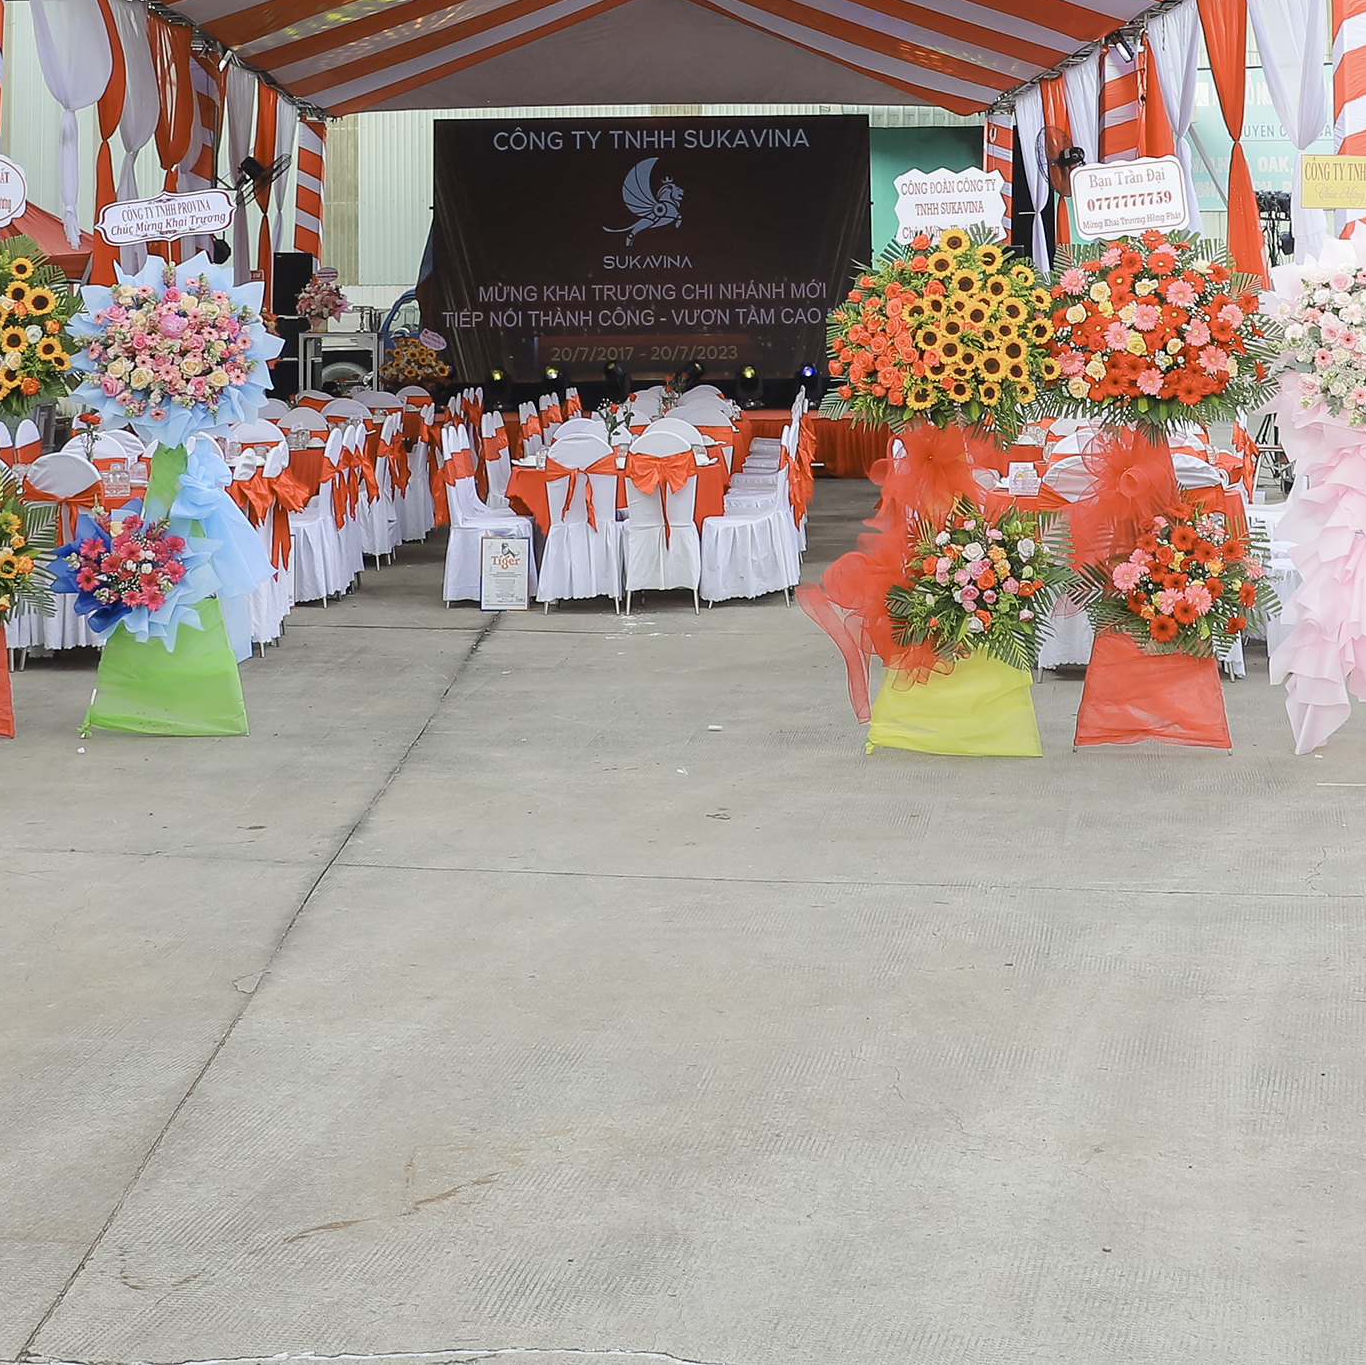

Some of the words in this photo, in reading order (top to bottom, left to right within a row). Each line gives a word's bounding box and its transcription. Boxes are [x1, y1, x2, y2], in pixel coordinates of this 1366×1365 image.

[493, 127, 563, 151] CÔNG
[571, 130, 602, 149] TY
[609, 130, 676, 149] TNHH
[684, 128, 810, 149] SUKAVINA
[1088, 174, 1112, 190] Bạn
[1114, 169, 1144, 185] Trần
[1146, 167, 1166, 184] Đại
[1304, 156, 1331, 182] CÔNG
[1333, 162, 1346, 182] TY
[900, 179, 928, 195] CÔNG
[930, 178, 955, 194] ĐOÀN
[956, 177, 984, 193] CÔNG
[985, 178, 997, 191] TY
[121, 205, 144, 222] CÔNG
[144, 206, 156, 219] TY
[155, 203, 176, 218] TNHH
[178, 199, 212, 214] PROVINA
[915, 202, 940, 216] TNHH
[940, 200, 985, 215] SUKAVINA
[1087, 189, 1173, 212] 0777777759
[110, 223, 134, 236] Chúc
[135, 220, 163, 233] Mừng
[165, 216, 187, 228] Khai
[189, 213, 226, 225] Trương
[602, 255, 693, 270] SUKAVINA
[479, 282, 538, 302] MỪNG
[543, 285, 585, 301] KHAI
[591, 284, 676, 301] TRƯƠNG
[681, 284, 713, 300] CHI
[719, 280, 785, 299] NHÁNH
[790, 279, 827, 299] MỚI
[442, 307, 484, 328] TIẾP
[489, 307, 522, 328] NỐI
[527, 306, 593, 327] THÀNH
[598, 307, 655, 327] CÔNG
[671, 308, 730, 326] VƯƠN
[781, 307, 822, 325] CAO
[550, 346, 635, 363] 20/7/2017
[650, 345, 738, 361] 20/7/2023
[491, 555, 521, 570] Tiger
